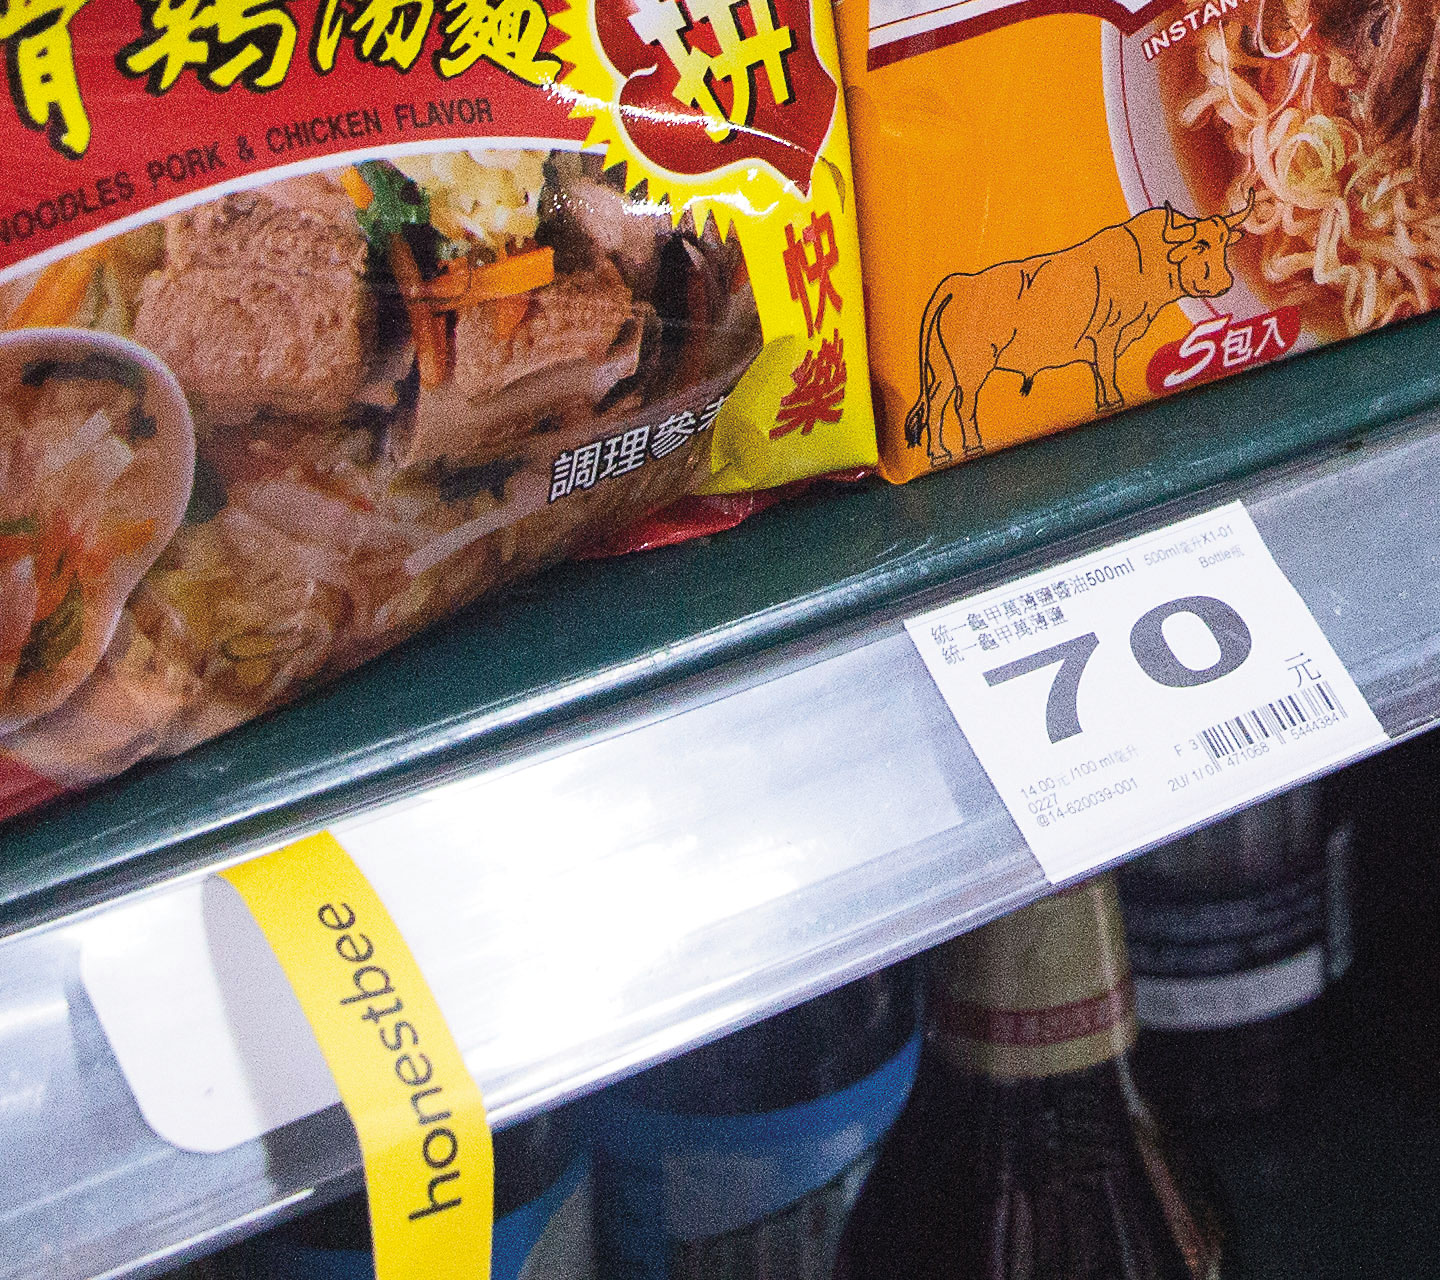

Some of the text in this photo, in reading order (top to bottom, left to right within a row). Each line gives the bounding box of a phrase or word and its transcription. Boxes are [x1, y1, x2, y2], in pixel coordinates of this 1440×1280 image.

[149, 150, 227, 191] PORK
[236, 134, 253, 158] &
[266, 106, 384, 155] CHICKEN
[395, 96, 496, 131] FLAVOR
[1172, 314, 1289, 386] 5包入
[982, 594, 1253, 746] 70
[1283, 651, 1324, 689] 元
[316, 899, 463, 1224] honestbee
